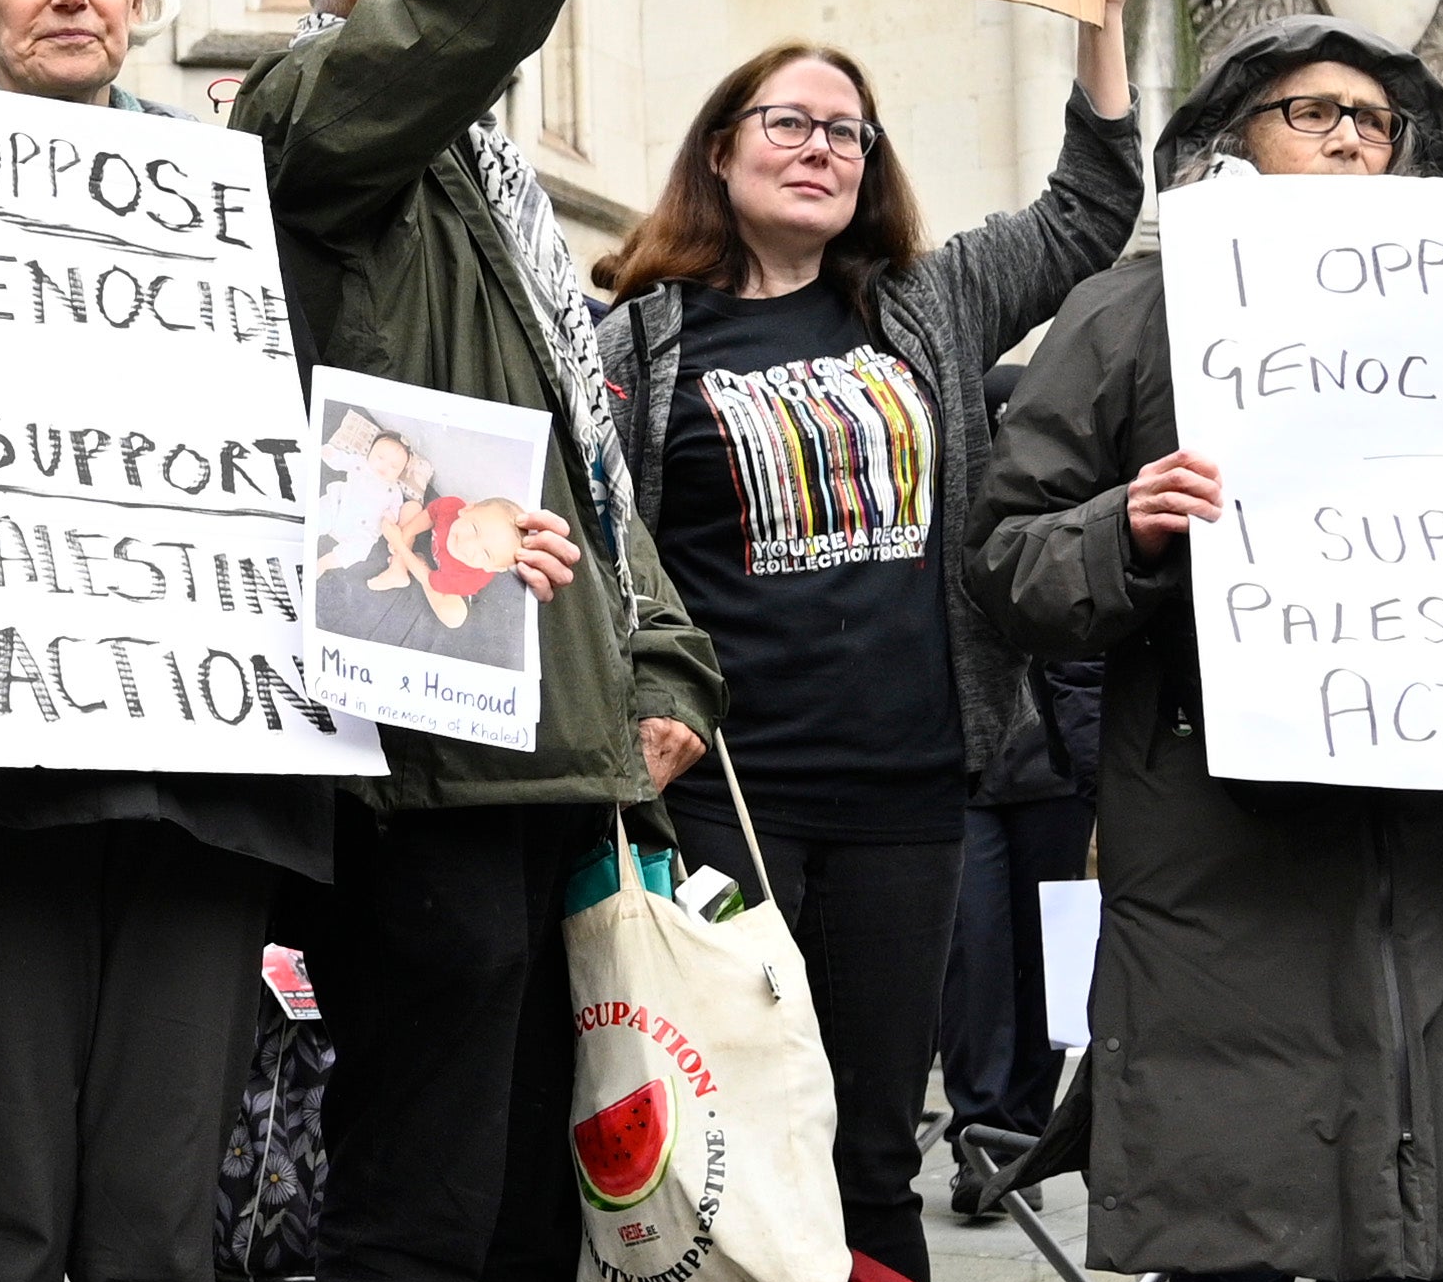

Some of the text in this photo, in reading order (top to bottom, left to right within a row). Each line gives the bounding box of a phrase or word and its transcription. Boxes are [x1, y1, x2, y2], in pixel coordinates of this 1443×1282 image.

[1232, 238, 1247, 307] I
[752, 532, 847, 559] YOU'RE
[852, 529, 869, 545] A
[1234, 498, 1255, 563] I
[321, 645, 372, 684] Mira
[424, 672, 515, 716] Hamoud
[355, 693, 367, 713] in
[378, 706, 437, 731] memory
[447, 718, 460, 733] of
[471, 720, 529, 748] Khaled)
[574, 1001, 716, 1098] CCUPATION
[682, 1129, 725, 1269] PAESTINE
